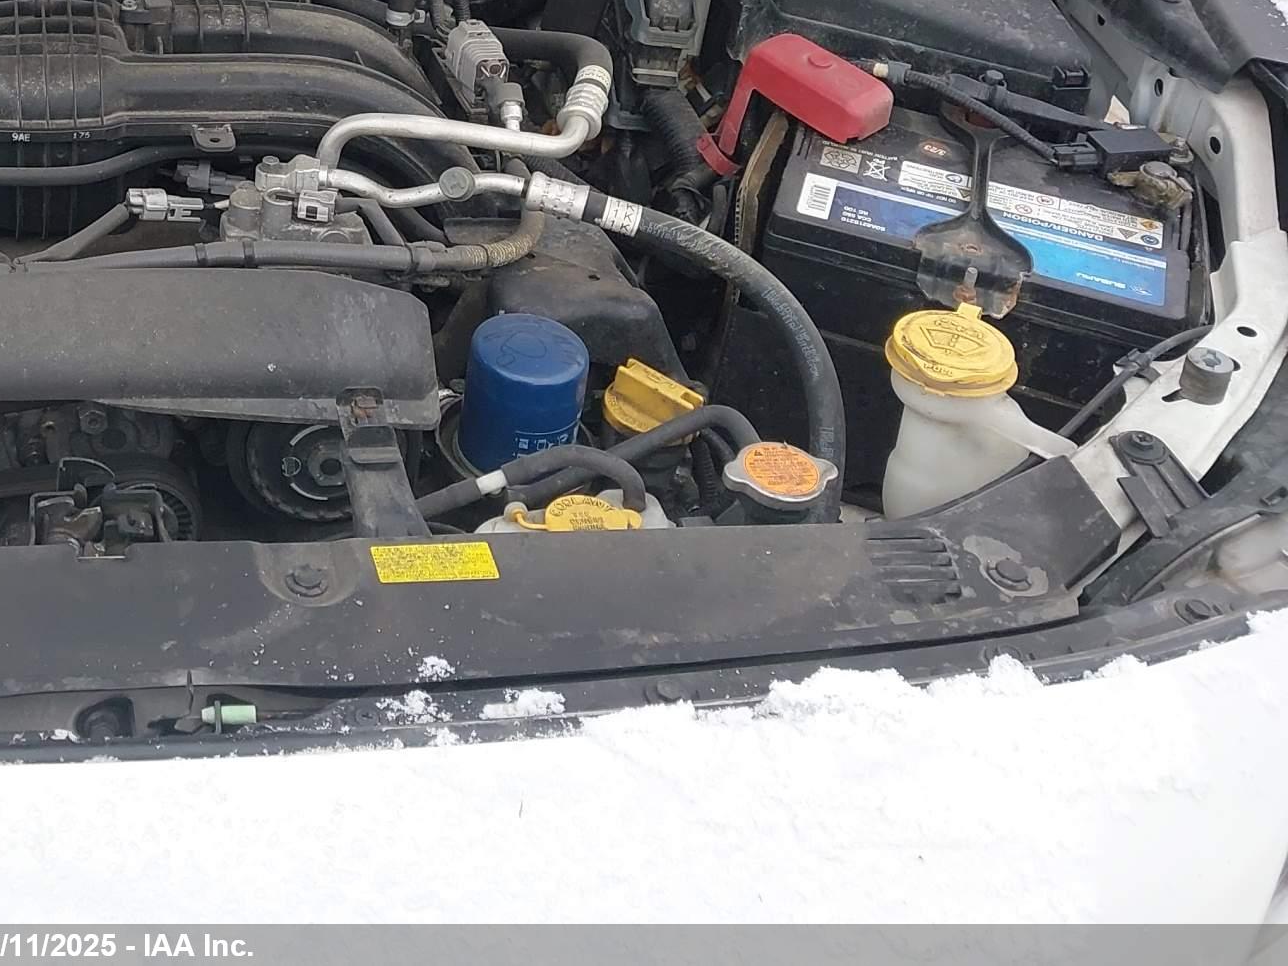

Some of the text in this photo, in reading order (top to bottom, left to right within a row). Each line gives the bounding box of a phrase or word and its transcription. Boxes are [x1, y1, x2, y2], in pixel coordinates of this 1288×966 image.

[10, 132, 31, 142] 9AE
[1002, 210, 1103, 241] DANGER/POISON
[1075, 271, 1126, 289] SUBARU
